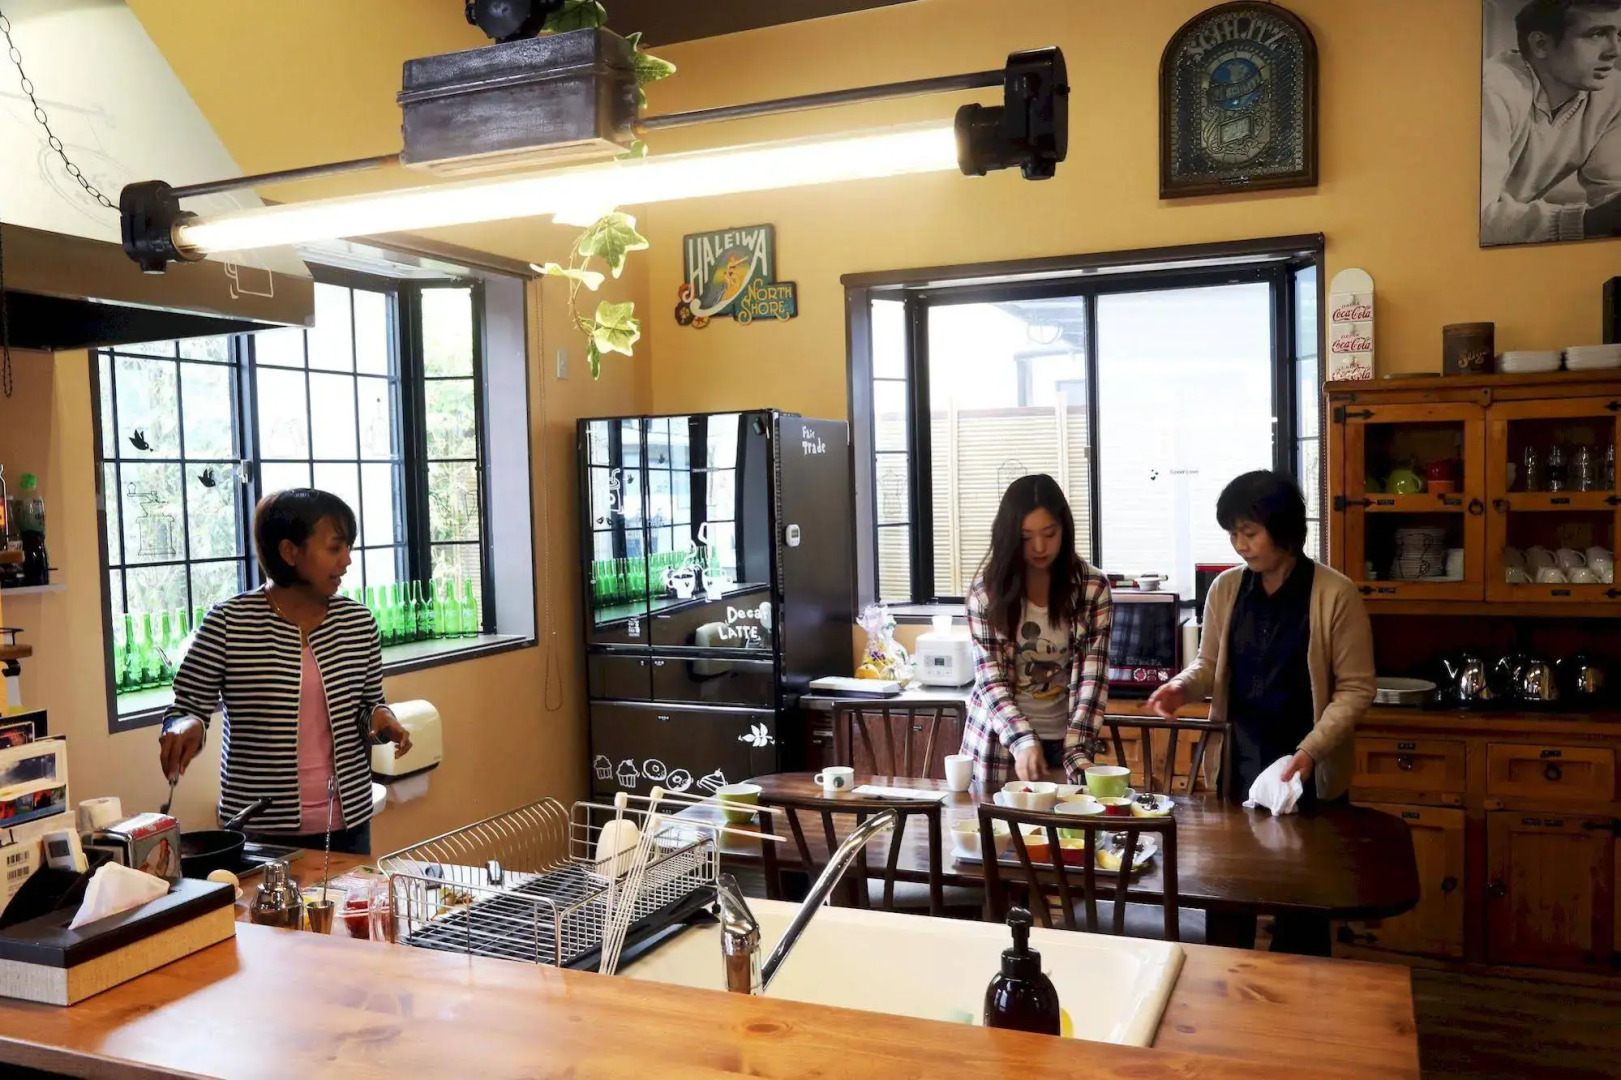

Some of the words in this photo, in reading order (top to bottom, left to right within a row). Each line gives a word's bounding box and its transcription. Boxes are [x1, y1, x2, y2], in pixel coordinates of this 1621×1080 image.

[682, 229, 768, 303] HALEIWA
[747, 278, 793, 301] NORTH
[738, 297, 790, 324] SHORE
[802, 425, 816, 439] Fair
[802, 437, 826, 456] Trade
[717, 625, 758, 641] LATTE
